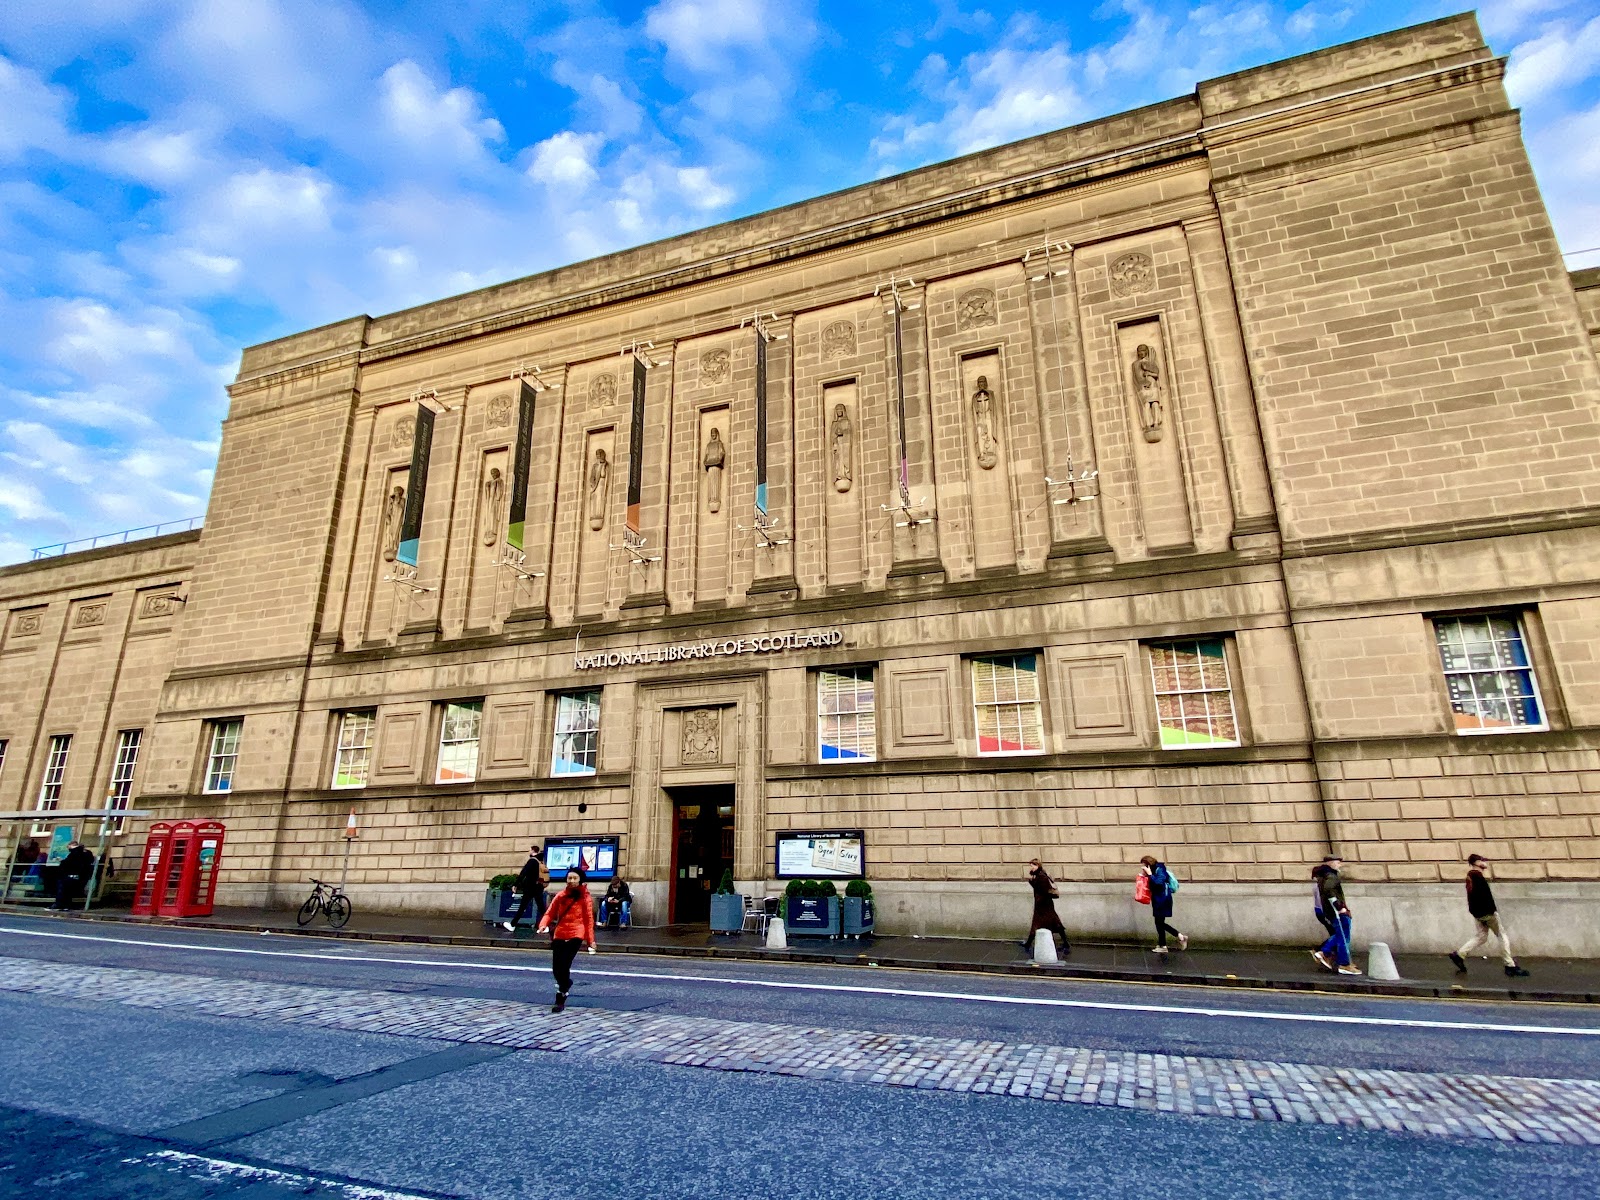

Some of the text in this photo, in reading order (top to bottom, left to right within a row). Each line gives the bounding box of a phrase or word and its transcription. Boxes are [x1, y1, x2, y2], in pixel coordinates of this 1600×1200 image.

[420, 422, 428, 456] Scotland
[574, 630, 843, 670] NATIONAL LIBRARY OF SCOTLAND
[840, 849, 858, 862] Story
